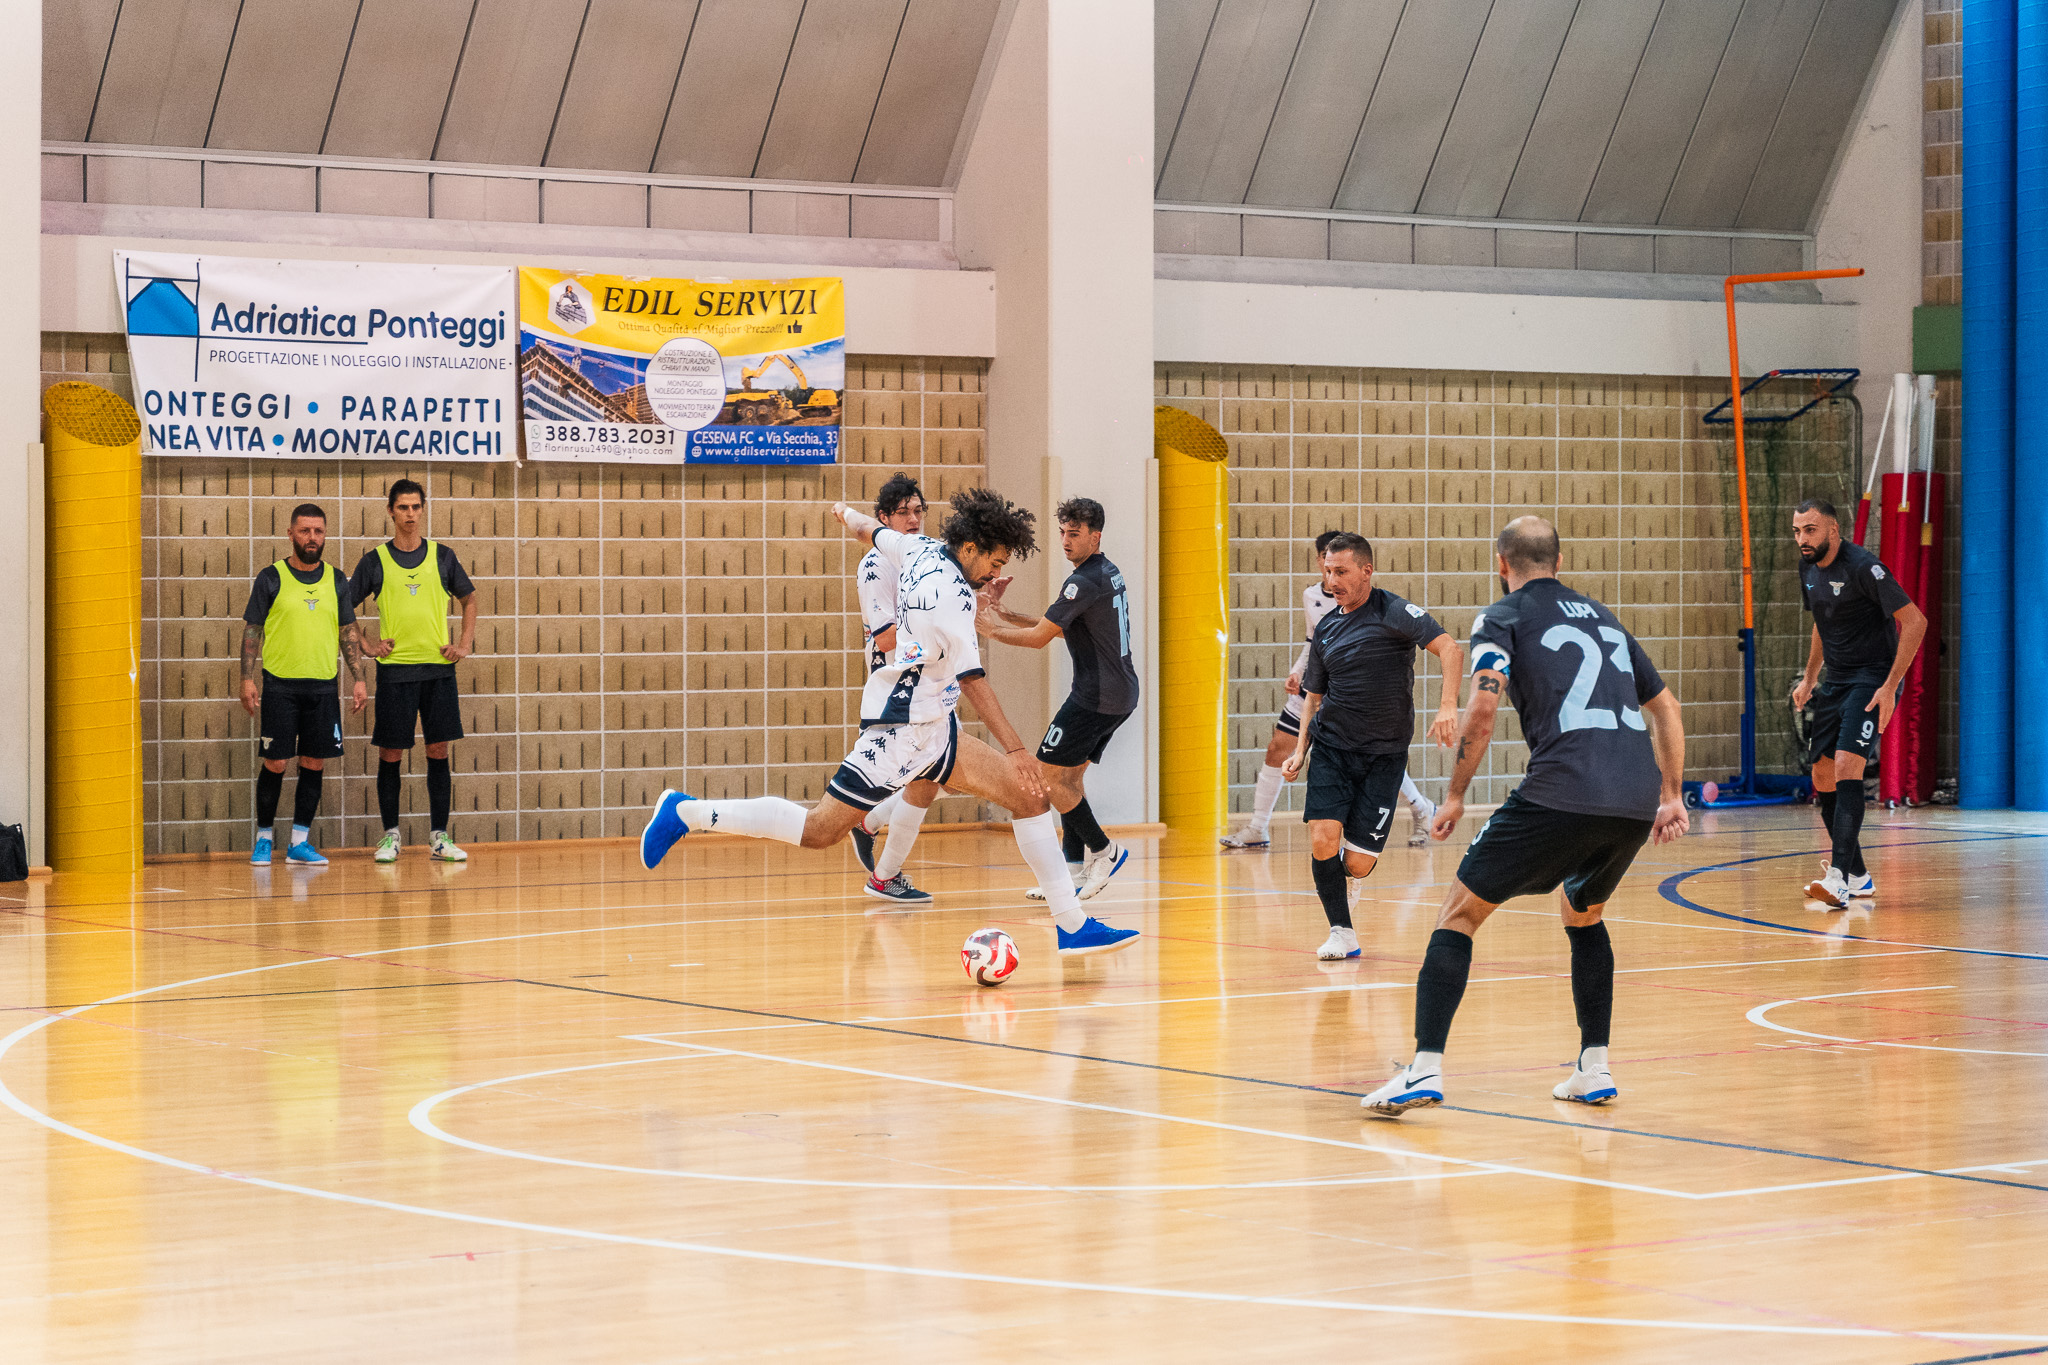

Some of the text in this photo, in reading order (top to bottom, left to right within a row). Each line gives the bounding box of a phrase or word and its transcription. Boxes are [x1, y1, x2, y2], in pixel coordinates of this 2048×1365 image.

[601, 286, 818, 317] EDIL SERVIZI
[210, 301, 505, 348] Adriatica Ponteggi
[618, 321, 650, 332] Ottima
[653, 322, 689, 337] Qualità
[705, 324, 741, 338] Miglior
[209, 350, 319, 366] PROGETTAZIONE
[331, 354, 401, 368] NOLEGGIO
[412, 357, 506, 370] INSTALLAZIONE
[657, 356, 716, 366] RISTRUTTURAZIONE
[664, 349, 713, 358] COSTRUZIONE E
[661, 364, 680, 372] CHIAVI
[691, 365, 710, 373] MANO
[654, 387, 717, 396] NOLEGGIO PONTEGGI
[667, 380, 703, 388] MONTAGGIO
[144, 390, 501, 423] ONTEGGI PARAPETTI
[657, 403, 695, 411] MOVIMENTO
[666, 411, 707, 419] ESCAVAZIONE
[148, 424, 501, 456] NEA VITA MONTACARICHI
[545, 425, 674, 445] 388.783.2031
[693, 431, 737, 445] CESENA
[739, 431, 754, 445] FC
[766, 431, 782, 445] Via
[783, 431, 823, 446] Secchia,
[544, 443, 673, 456] florinrusu2490@yahoo.com
[1556, 600, 1600, 619] LUPI
[1478, 675, 1500, 695] 23
[1540, 624, 1647, 734] 23
[1044, 723, 1063, 747] 10
[1861, 720, 1874, 740] 9
[1375, 806, 1390, 830] 7
